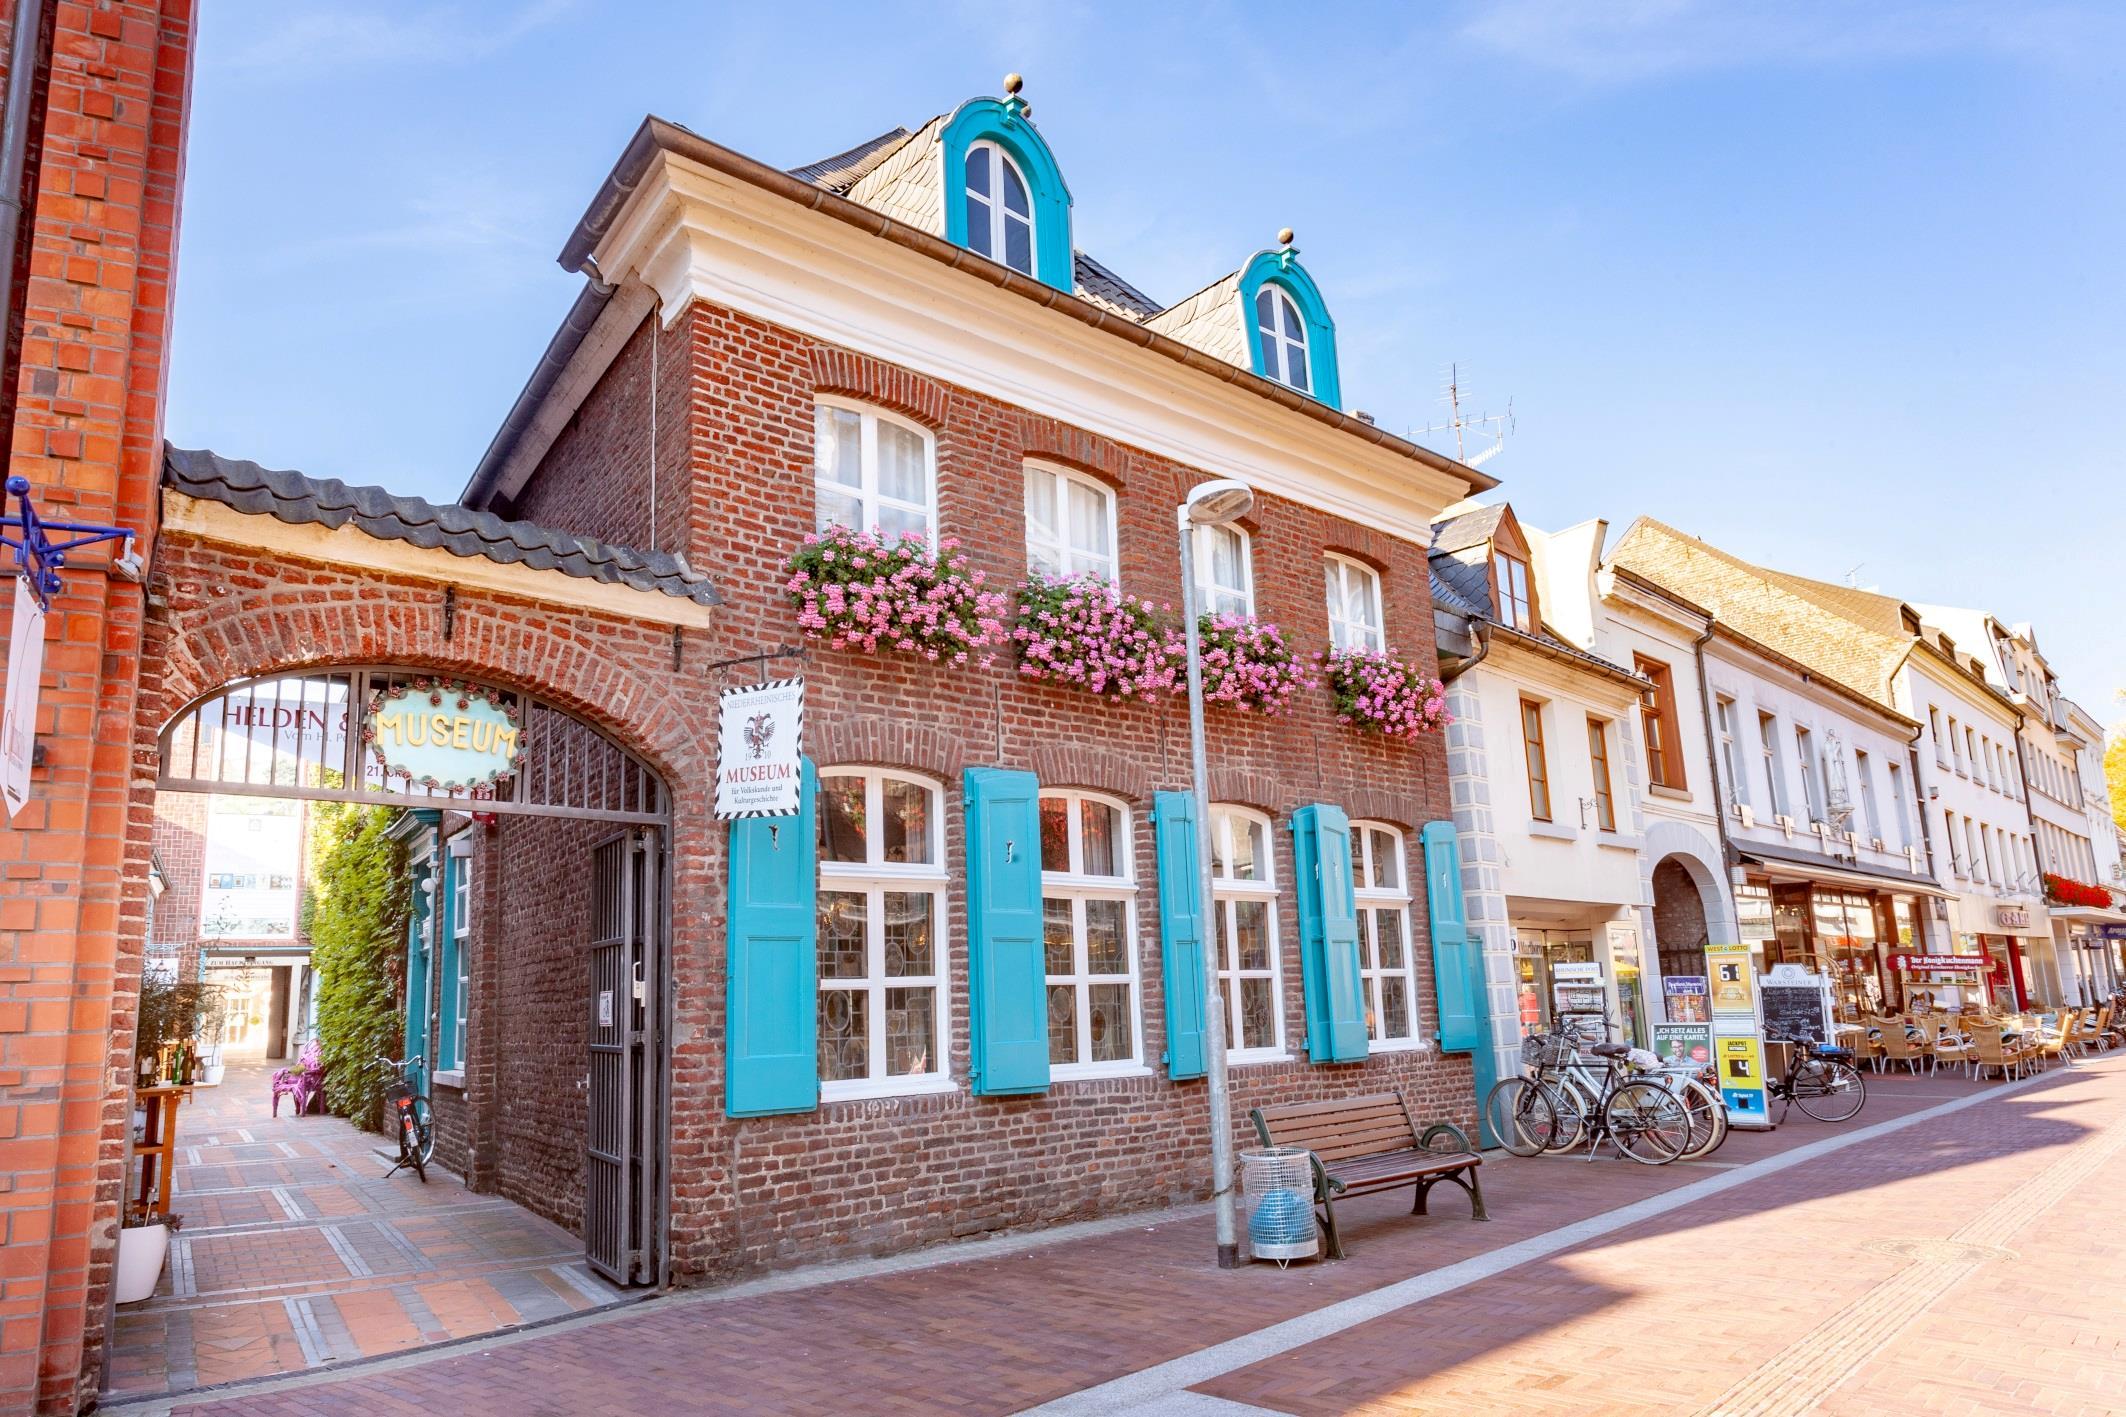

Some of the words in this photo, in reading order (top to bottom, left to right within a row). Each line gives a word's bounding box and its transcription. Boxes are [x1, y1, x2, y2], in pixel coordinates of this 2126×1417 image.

[376, 711, 517, 759] MUSEUM
[726, 763, 790, 783] MUSEUM
[731, 787, 740, 795] für
[740, 785, 770, 794] Volkskunde
[771, 784, 783, 792] und
[734, 795, 778, 805] Kulturgeschichte
